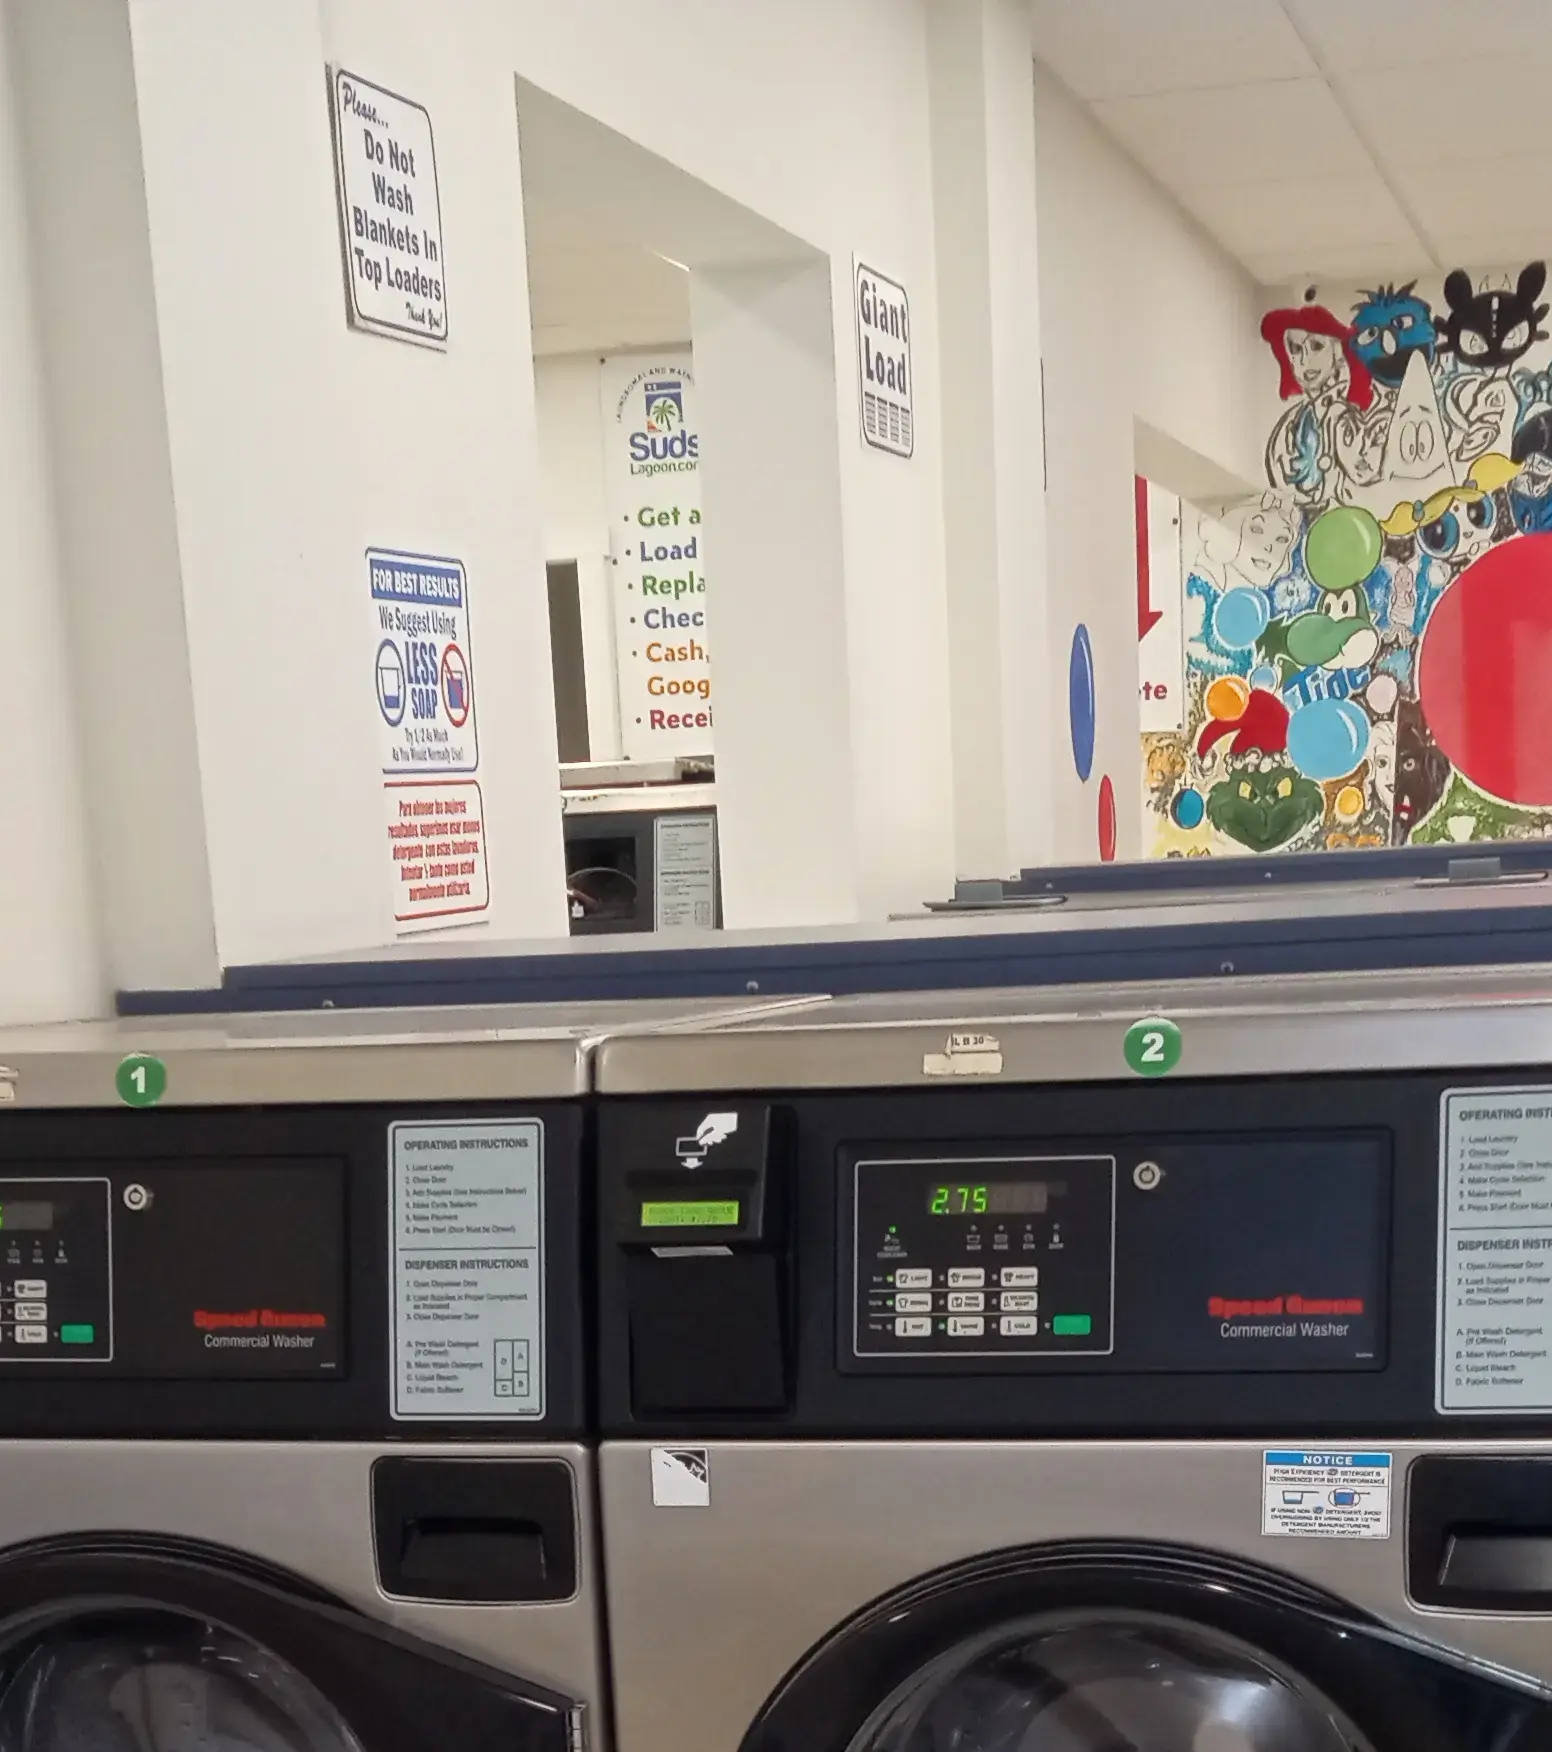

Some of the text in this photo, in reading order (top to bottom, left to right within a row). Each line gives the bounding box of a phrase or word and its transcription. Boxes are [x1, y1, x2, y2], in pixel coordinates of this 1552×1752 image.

[342, 80, 389, 129] Please...
[364, 128, 416, 178] Do Not
[371, 171, 414, 216] Wash
[352, 205, 438, 262] Blankets In
[354, 246, 442, 302] Top Loaders
[860, 278, 908, 345] Giant
[864, 334, 907, 396] Load
[629, 428, 698, 462] Suds
[638, 505, 701, 528] Get a
[640, 536, 698, 562] Load
[372, 567, 459, 600] FOR BEST RESULTS
[379, 605, 457, 640] We Suggest Using
[404, 640, 438, 687] LESS
[646, 638, 711, 664] Cash,
[648, 675, 711, 700] Goog
[411, 687, 438, 720] SOAP
[1141, 1032, 1165, 1062] 2
[130, 1066, 146, 1094] 1
[1459, 1108, 1523, 1122] OPERATING
[404, 1138, 529, 1151] OPERATING INSTRUCTIONS
[931, 1186, 987, 1214] 2.75
[1457, 1238, 1520, 1251] DISPENSER
[405, 1258, 530, 1271] DISPENSER INSTRUCTIONS
[204, 1333, 315, 1348] Commercial Washer
[1220, 1322, 1350, 1338] Commercial Washer
[1302, 1455, 1353, 1466] NOTICE
